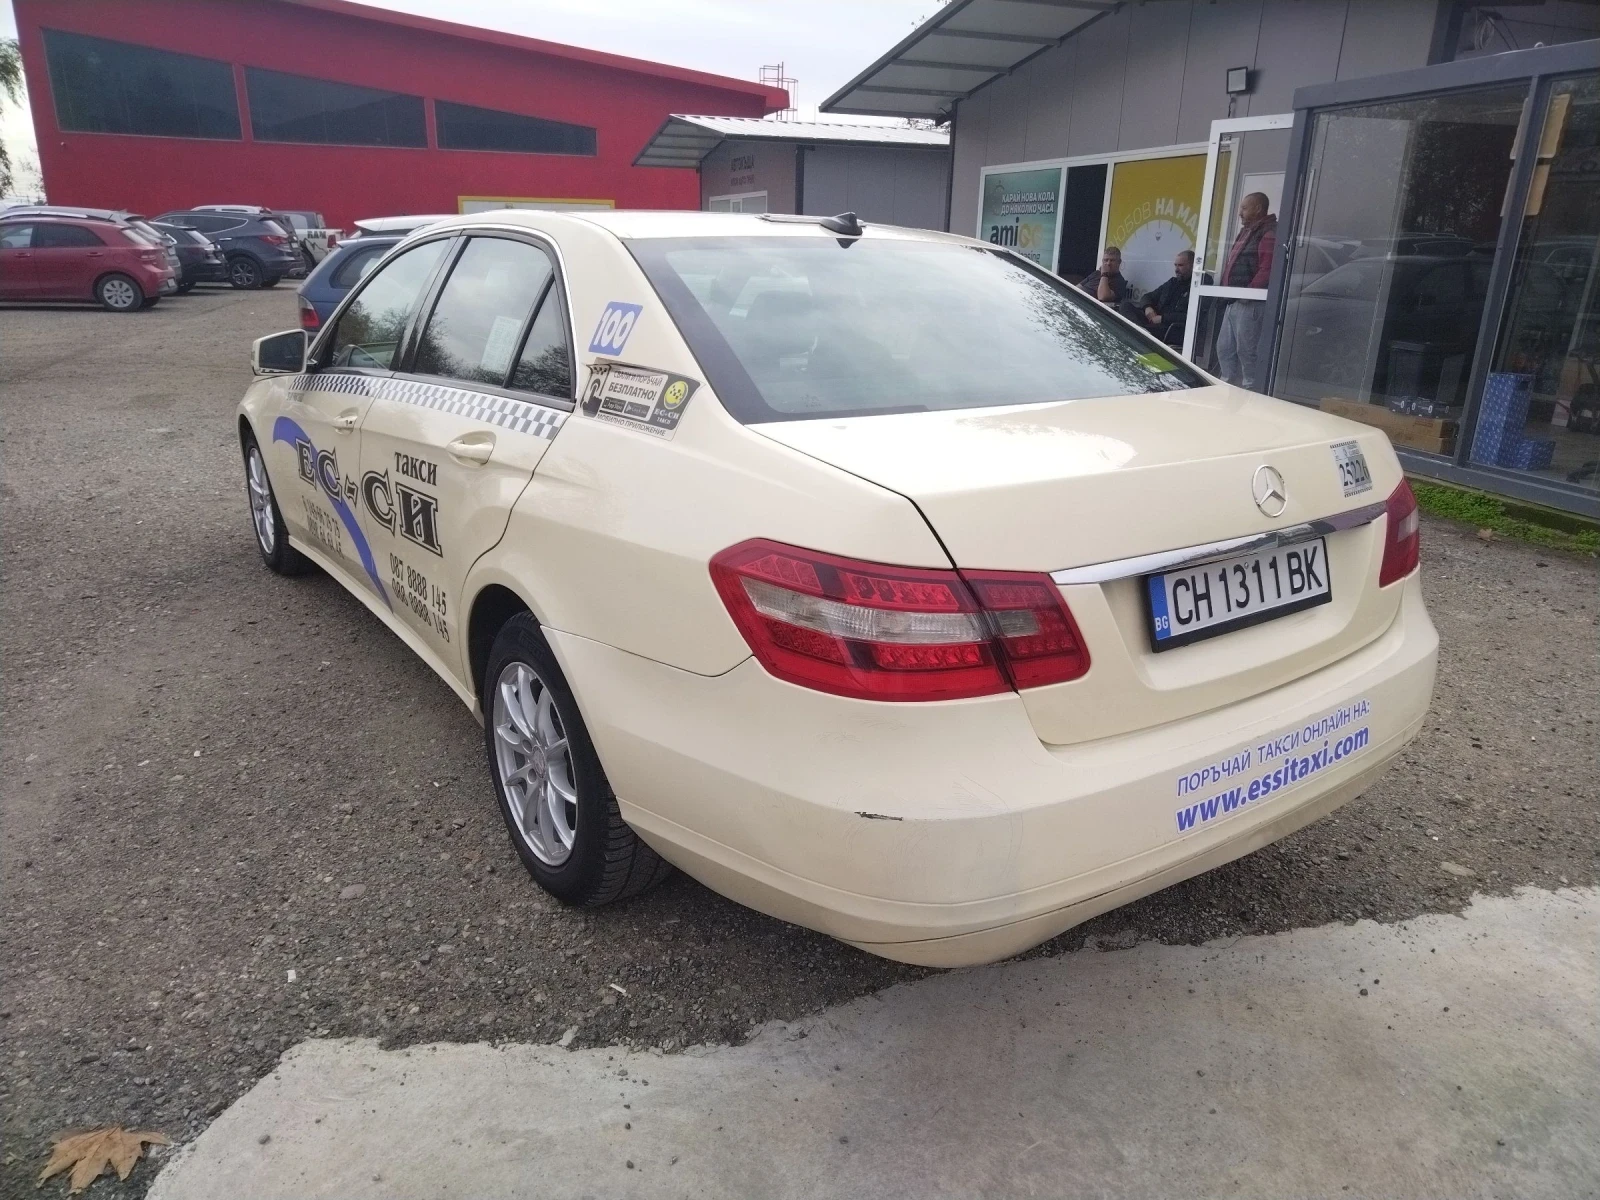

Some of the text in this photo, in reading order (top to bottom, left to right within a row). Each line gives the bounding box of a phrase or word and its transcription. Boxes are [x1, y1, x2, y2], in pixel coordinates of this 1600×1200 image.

[1002, 190, 1055, 203] КАРАЙ НОВА КОЛА
[1155, 198, 1174, 217] НА
[1001, 203, 1054, 216] ДО НЯКОЛКО ЧАСА
[307, 230, 327, 239] RAM
[593, 307, 635, 349] 100
[608, 381, 657, 401] БЕЗПЛАТНО!
[597, 413, 666, 437] МОБИЛНО ПРИЛОЖЕНИЕ
[390, 552, 447, 616] 087 8888 145
[432, 612, 450, 643] 145
[1155, 616, 1169, 632] BG
[1177, 700, 1370, 796] ПОРЪЧАЙ ТАКСИ ОНЛАЙН НА:
[1176, 727, 1369, 831] www.essitaxi.com
